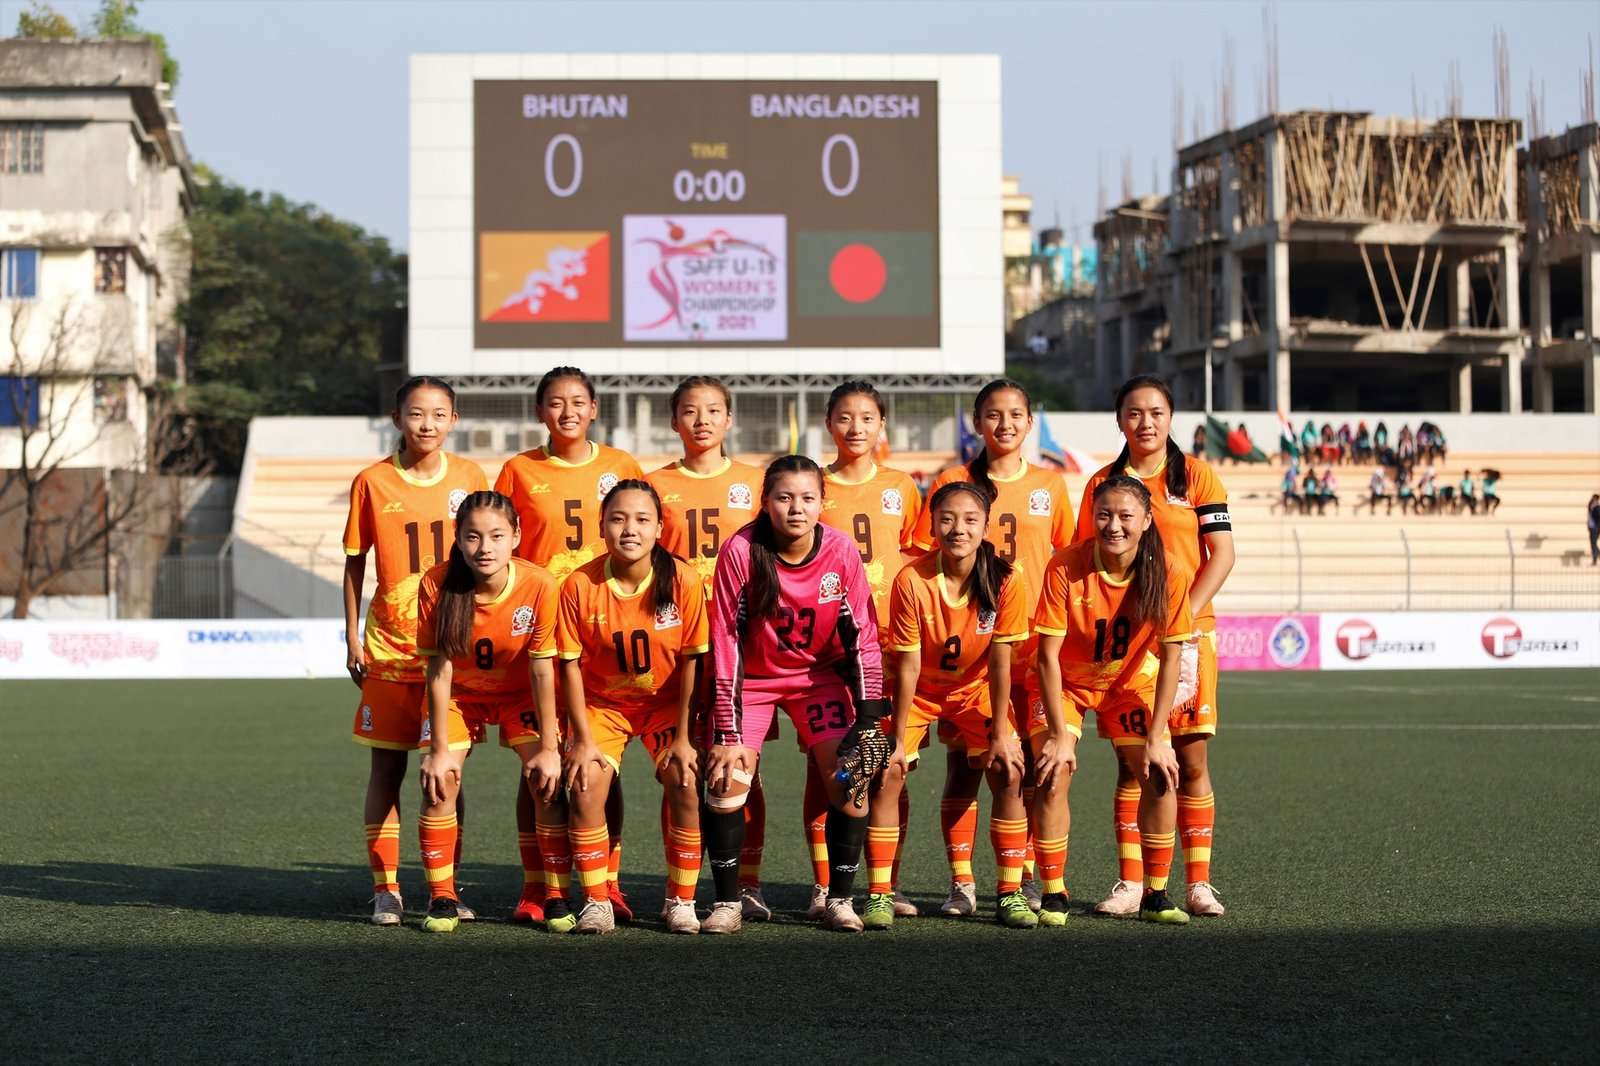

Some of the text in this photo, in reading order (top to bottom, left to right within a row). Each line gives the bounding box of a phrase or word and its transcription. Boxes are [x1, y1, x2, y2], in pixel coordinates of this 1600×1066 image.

[522, 95, 628, 119] BHUTAN
[750, 95, 919, 119] BANGLADESH
[544, 134, 583, 197] 0
[691, 144, 727, 159] TIME
[821, 134, 860, 197] 0
[673, 170, 746, 201] 0:00
[683, 258, 727, 275] SAFF
[683, 280, 776, 294] WOMEN'S
[564, 499, 583, 550] 5
[686, 508, 719, 559] 15
[853, 513, 873, 563] 9
[999, 512, 1017, 563] 3
[405, 520, 444, 573] 11
[776, 607, 817, 652] 23
[1093, 616, 1130, 663] 18
[475, 638, 494, 671] 8
[612, 629, 651, 674] 10
[940, 635, 962, 672] 2
[805, 700, 848, 733] 23
[1120, 708, 1148, 737] 18
